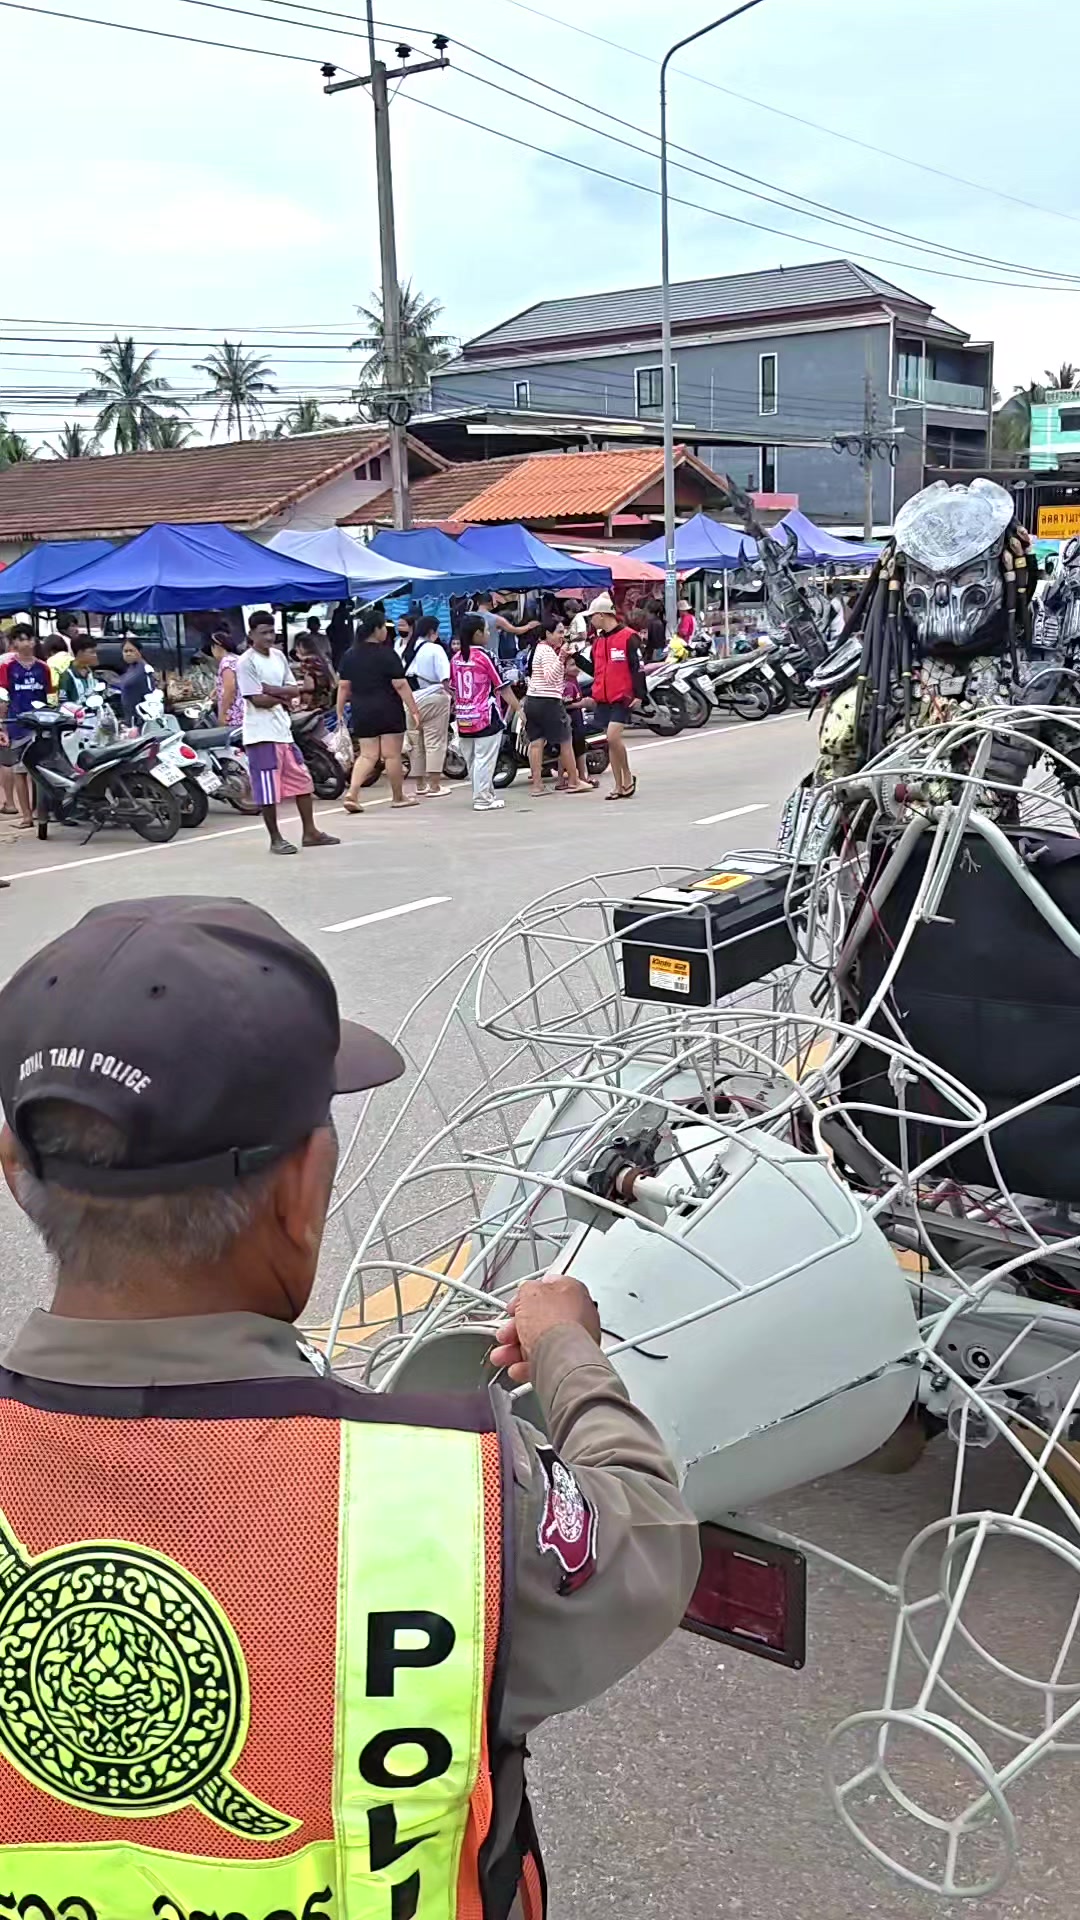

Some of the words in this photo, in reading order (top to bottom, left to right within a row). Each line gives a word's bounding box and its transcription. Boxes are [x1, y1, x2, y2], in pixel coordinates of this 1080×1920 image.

[456, 670, 474, 700] 19
[49, 1047, 86, 1069] THAI
[90, 1052, 152, 1095] POLICE
